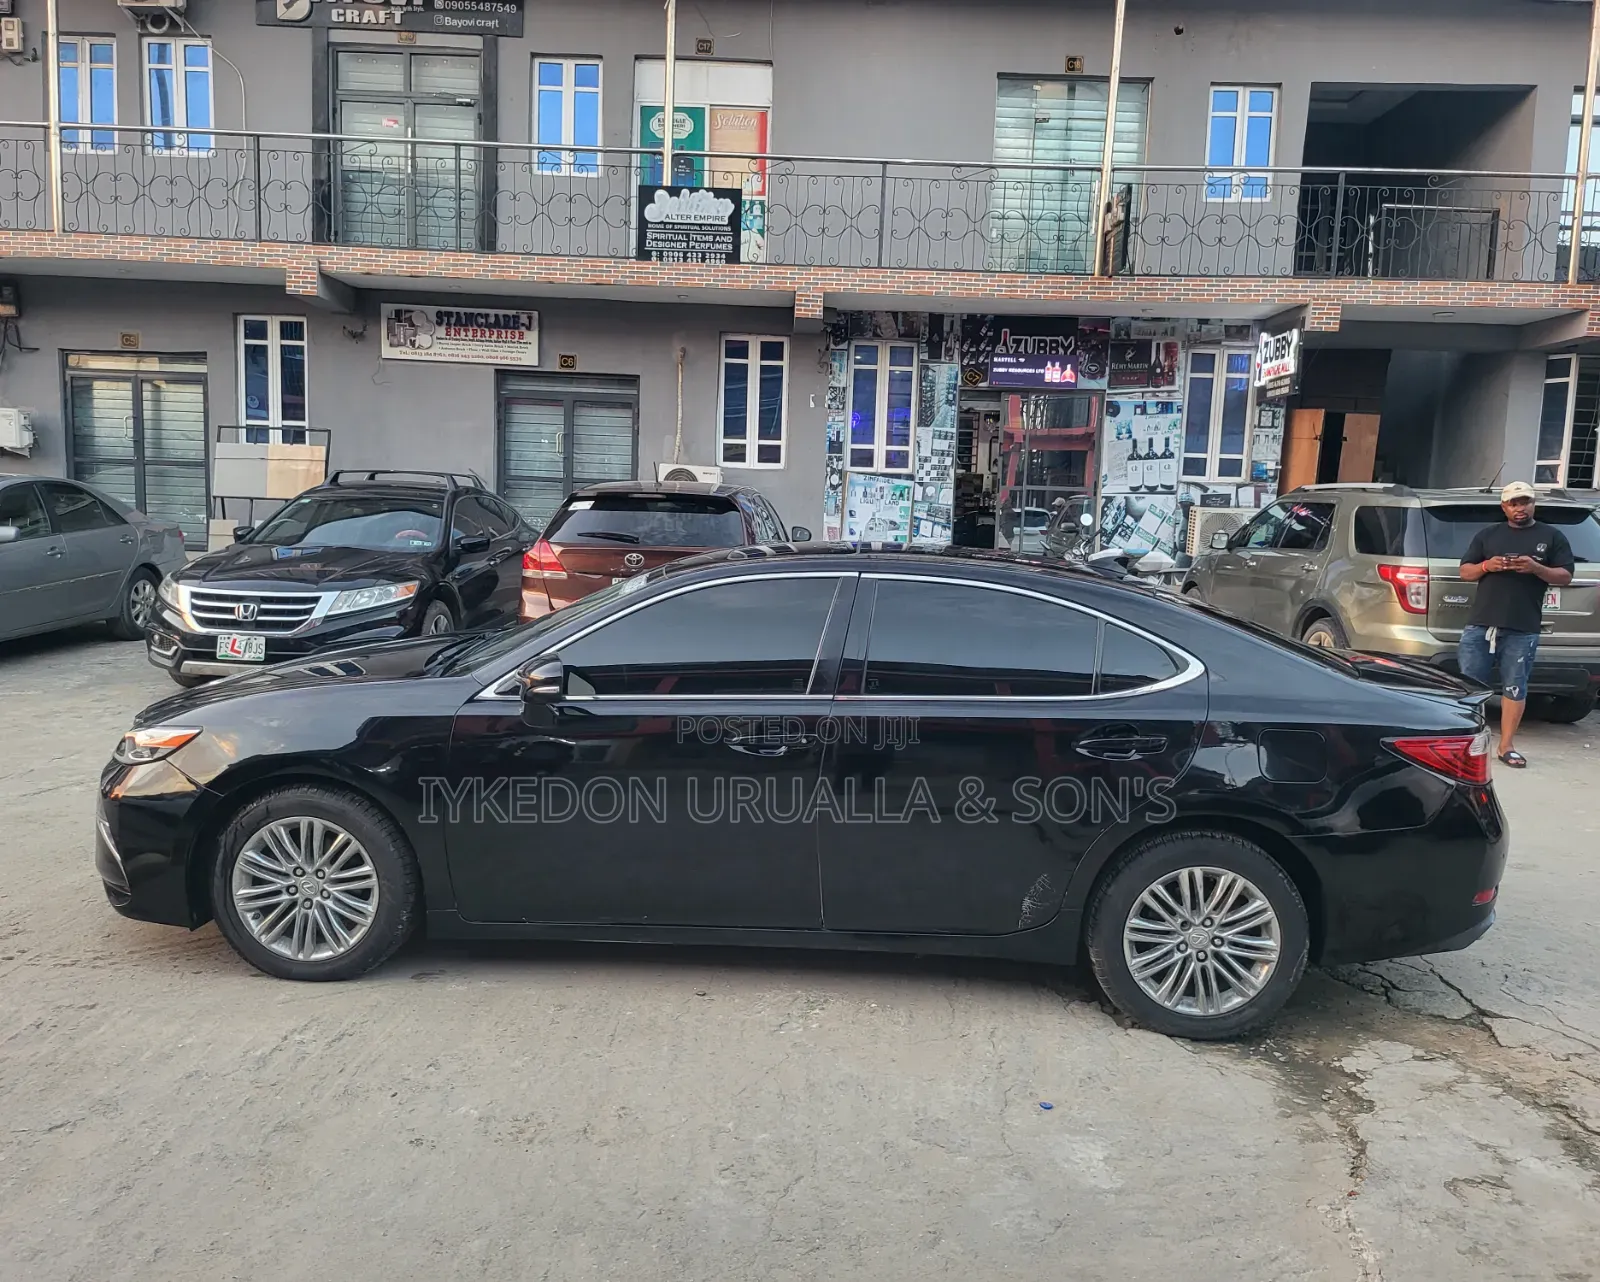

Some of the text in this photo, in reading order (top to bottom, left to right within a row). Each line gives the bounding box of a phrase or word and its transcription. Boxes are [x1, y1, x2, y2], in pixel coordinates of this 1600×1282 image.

[445, 1, 517, 13] 09055487549
[331, 8, 404, 24] CRAFT
[445, 17, 499, 29] Bayovi craft
[698, 42, 711, 51] C17
[714, 112, 759, 130] Solution
[646, 232, 733, 243] SPIRITUAL ITEMS AND
[646, 240, 733, 250] DESIGNER PERFUMES
[123, 335, 136, 345] C5
[445, 327, 526, 341] ENTERPRISE
[561, 357, 574, 366] C6
[966, 371, 979, 383] C7
